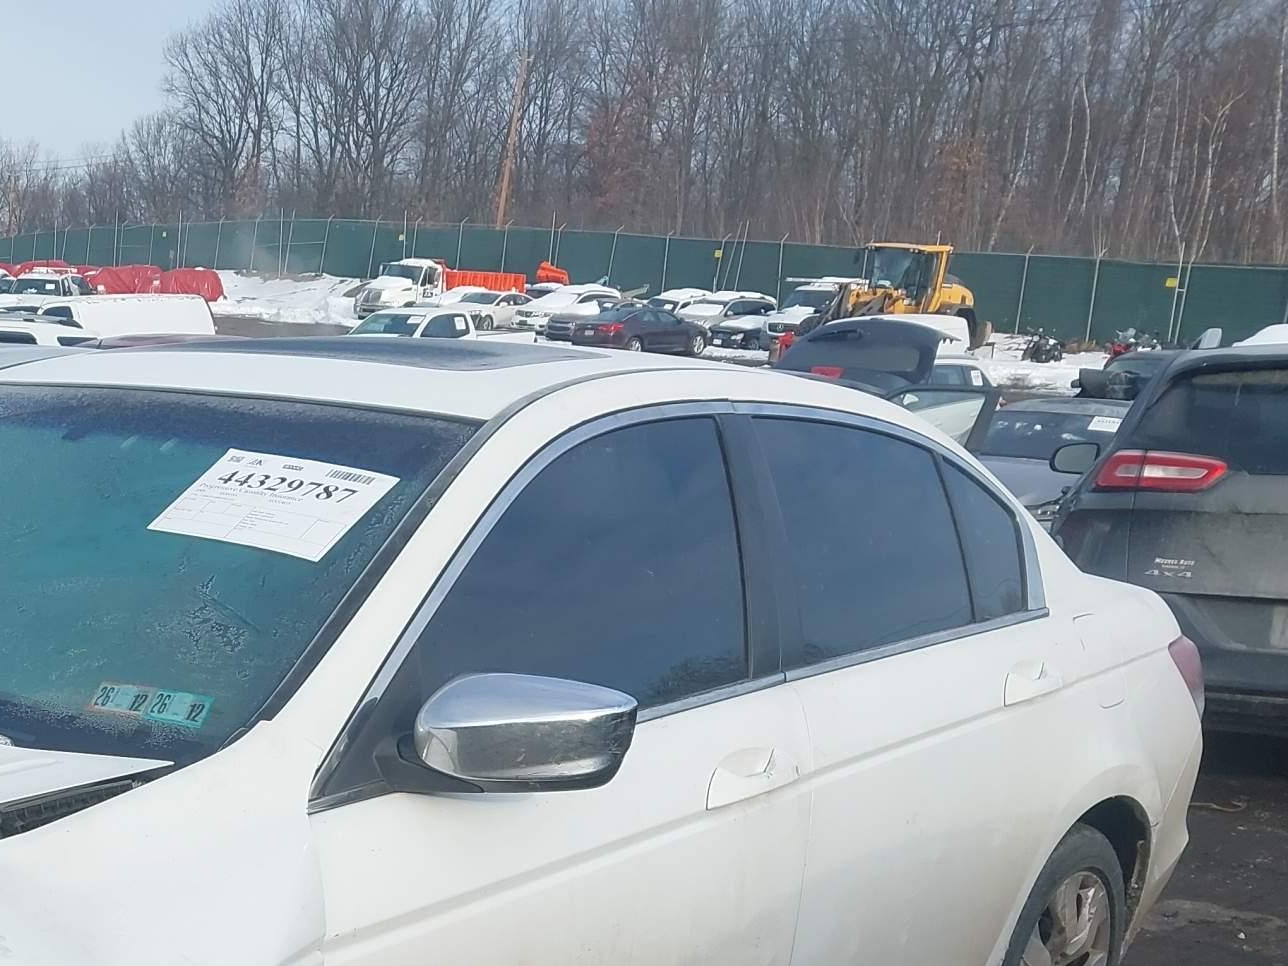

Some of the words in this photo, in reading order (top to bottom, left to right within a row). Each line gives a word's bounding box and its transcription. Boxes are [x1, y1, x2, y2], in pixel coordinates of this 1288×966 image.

[217, 469, 359, 504] 44329787
[128, 693, 149, 712] 12
[186, 703, 206, 722] 12
